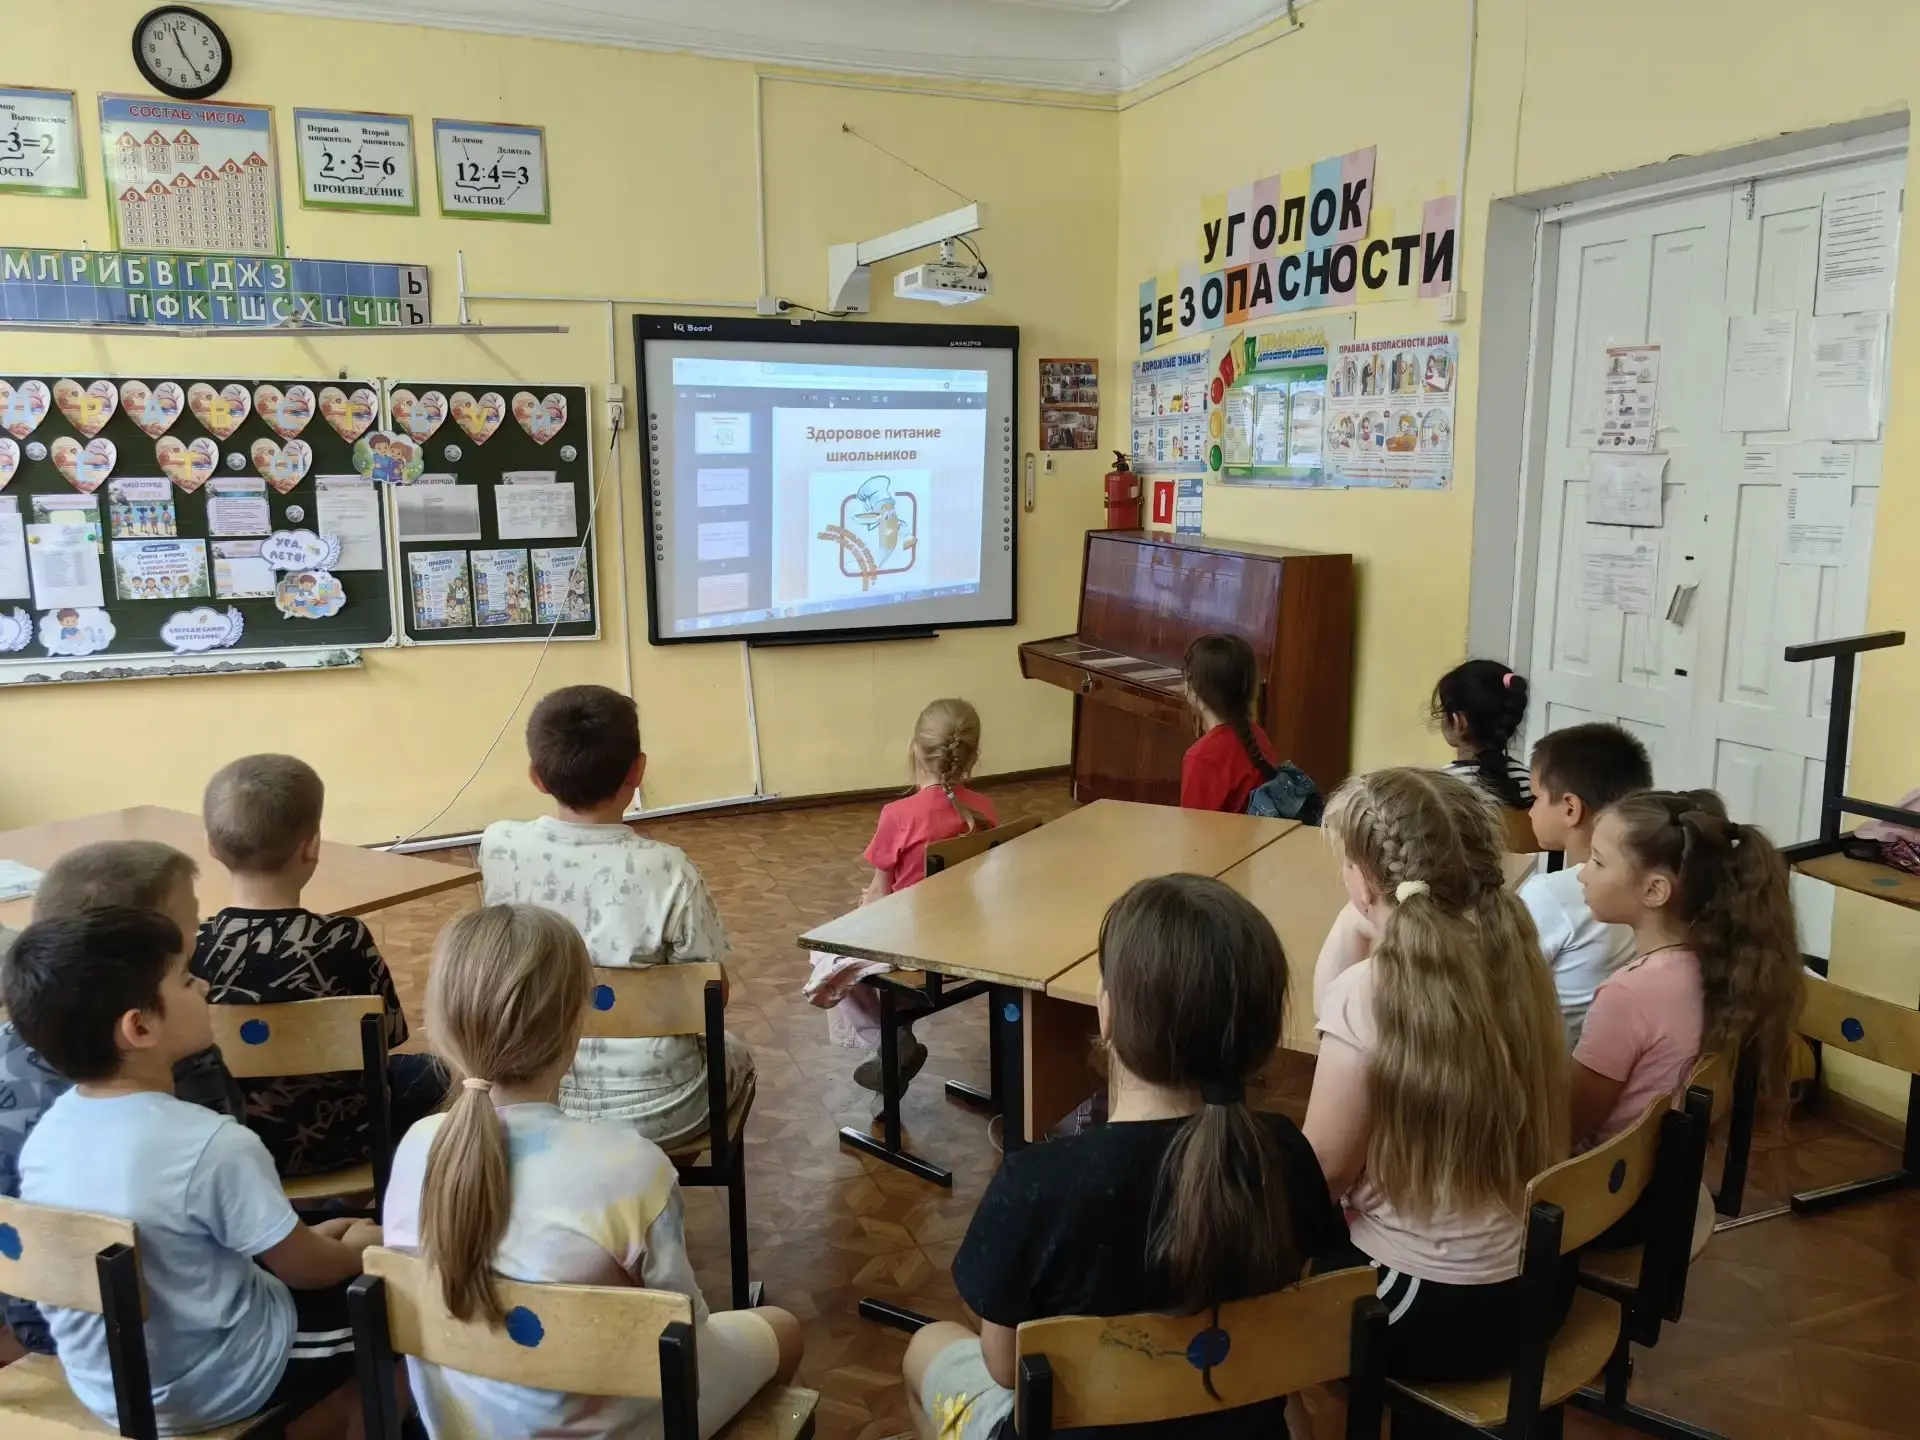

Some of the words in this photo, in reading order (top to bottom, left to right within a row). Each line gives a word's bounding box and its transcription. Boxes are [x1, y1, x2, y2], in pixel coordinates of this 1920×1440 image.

[164, 23, 170, 32] 11
[176, 21, 186, 31] 12
[193, 26, 196, 35] 1
[154, 31, 163, 40] 10
[202, 36, 208, 45] 2
[149, 44, 155, 52] 9
[209, 50, 214, 59] 3
[156, 59, 161, 68] 8
[204, 64, 210, 72] 4
[167, 68, 172, 77] 7
[195, 71, 200, 80] 5
[181, 74, 187, 83] 6
[130, 105, 192, 119] СОСТАВ
[196, 110, 247, 124] ЧИСЛА
[362, 128, 389, 138] Второй
[452, 136, 483, 144] Делимое
[314, 184, 405, 198] ПРОИЗВЕДЕНИЕ
[453, 194, 506, 206] ЧАСТНОЕ
[1204, 178, 1367, 264] УГОЛОК
[5, 254, 32, 280] М
[37, 255, 58, 280] Л
[71, 257, 87, 281] Р
[98, 256, 120, 283] Й
[127, 260, 144, 285] Б
[156, 261, 173, 285] В
[186, 262, 200, 285] Г
[212, 263, 233, 290] Д
[238, 264, 263, 287] Ж
[270, 265, 286, 288] З
[408, 272, 422, 295] Ь
[1139, 229, 1455, 344] БЕЗОПАСНОСТИ
[129, 294, 149, 319] П
[156, 294, 179, 319] Ф
[188, 296, 207, 320] К
[217, 296, 232, 320] Т
[241, 296, 265, 320] Ш
[272, 297, 289, 321] С
[300, 298, 317, 321] Х
[327, 300, 346, 326] Ц
[354, 301, 370, 324] Ч
[406, 304, 423, 325] Ъ
[1339, 343, 1370, 354] ПРАВИЛА
[1371, 337, 1425, 351] БЕЗОПАСНОСТИ
[1427, 335, 1448, 347] ДОМА
[1142, 358, 1176, 373] ДОРОЖНЫЕ
[1178, 352, 1200, 366] ЗНАКИ
[806, 426, 881, 442] Здоровое
[885, 428, 941, 439] питание
[827, 450, 916, 462] школьников
[494, 558, 518, 566] ЗАКОНЫ
